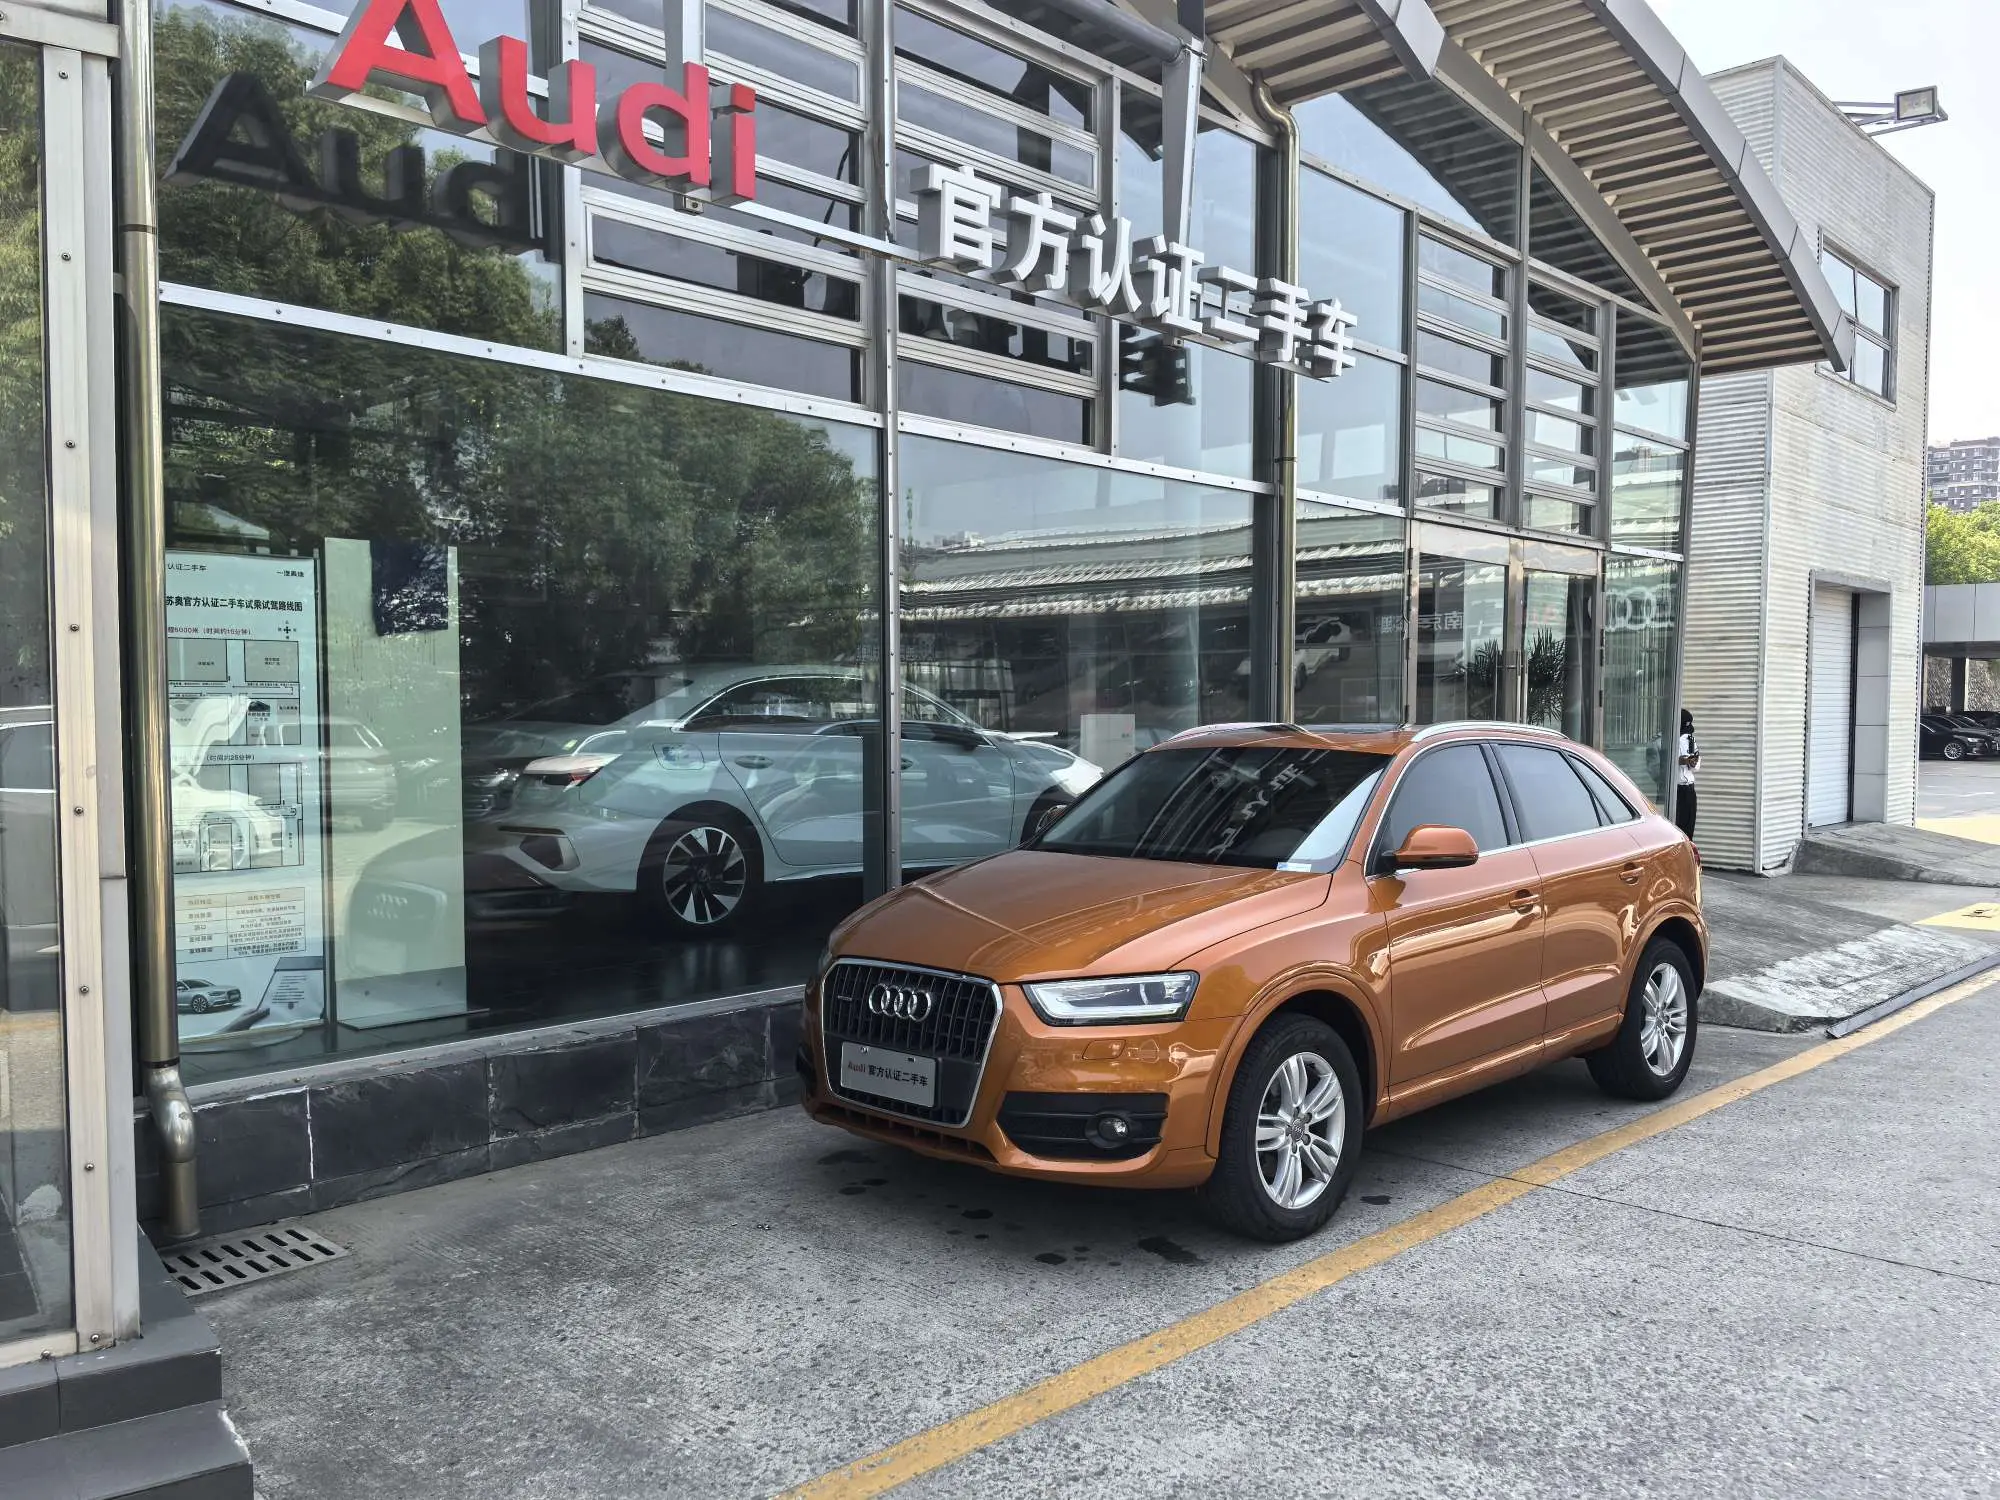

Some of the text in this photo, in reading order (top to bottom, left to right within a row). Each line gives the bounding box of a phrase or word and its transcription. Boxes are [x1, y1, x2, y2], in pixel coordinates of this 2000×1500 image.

[308, 0, 756, 205] Audi
[911, 163, 1358, 378] 官方认证二手车
[868, 1065, 929, 1087] 官方认证二手车
